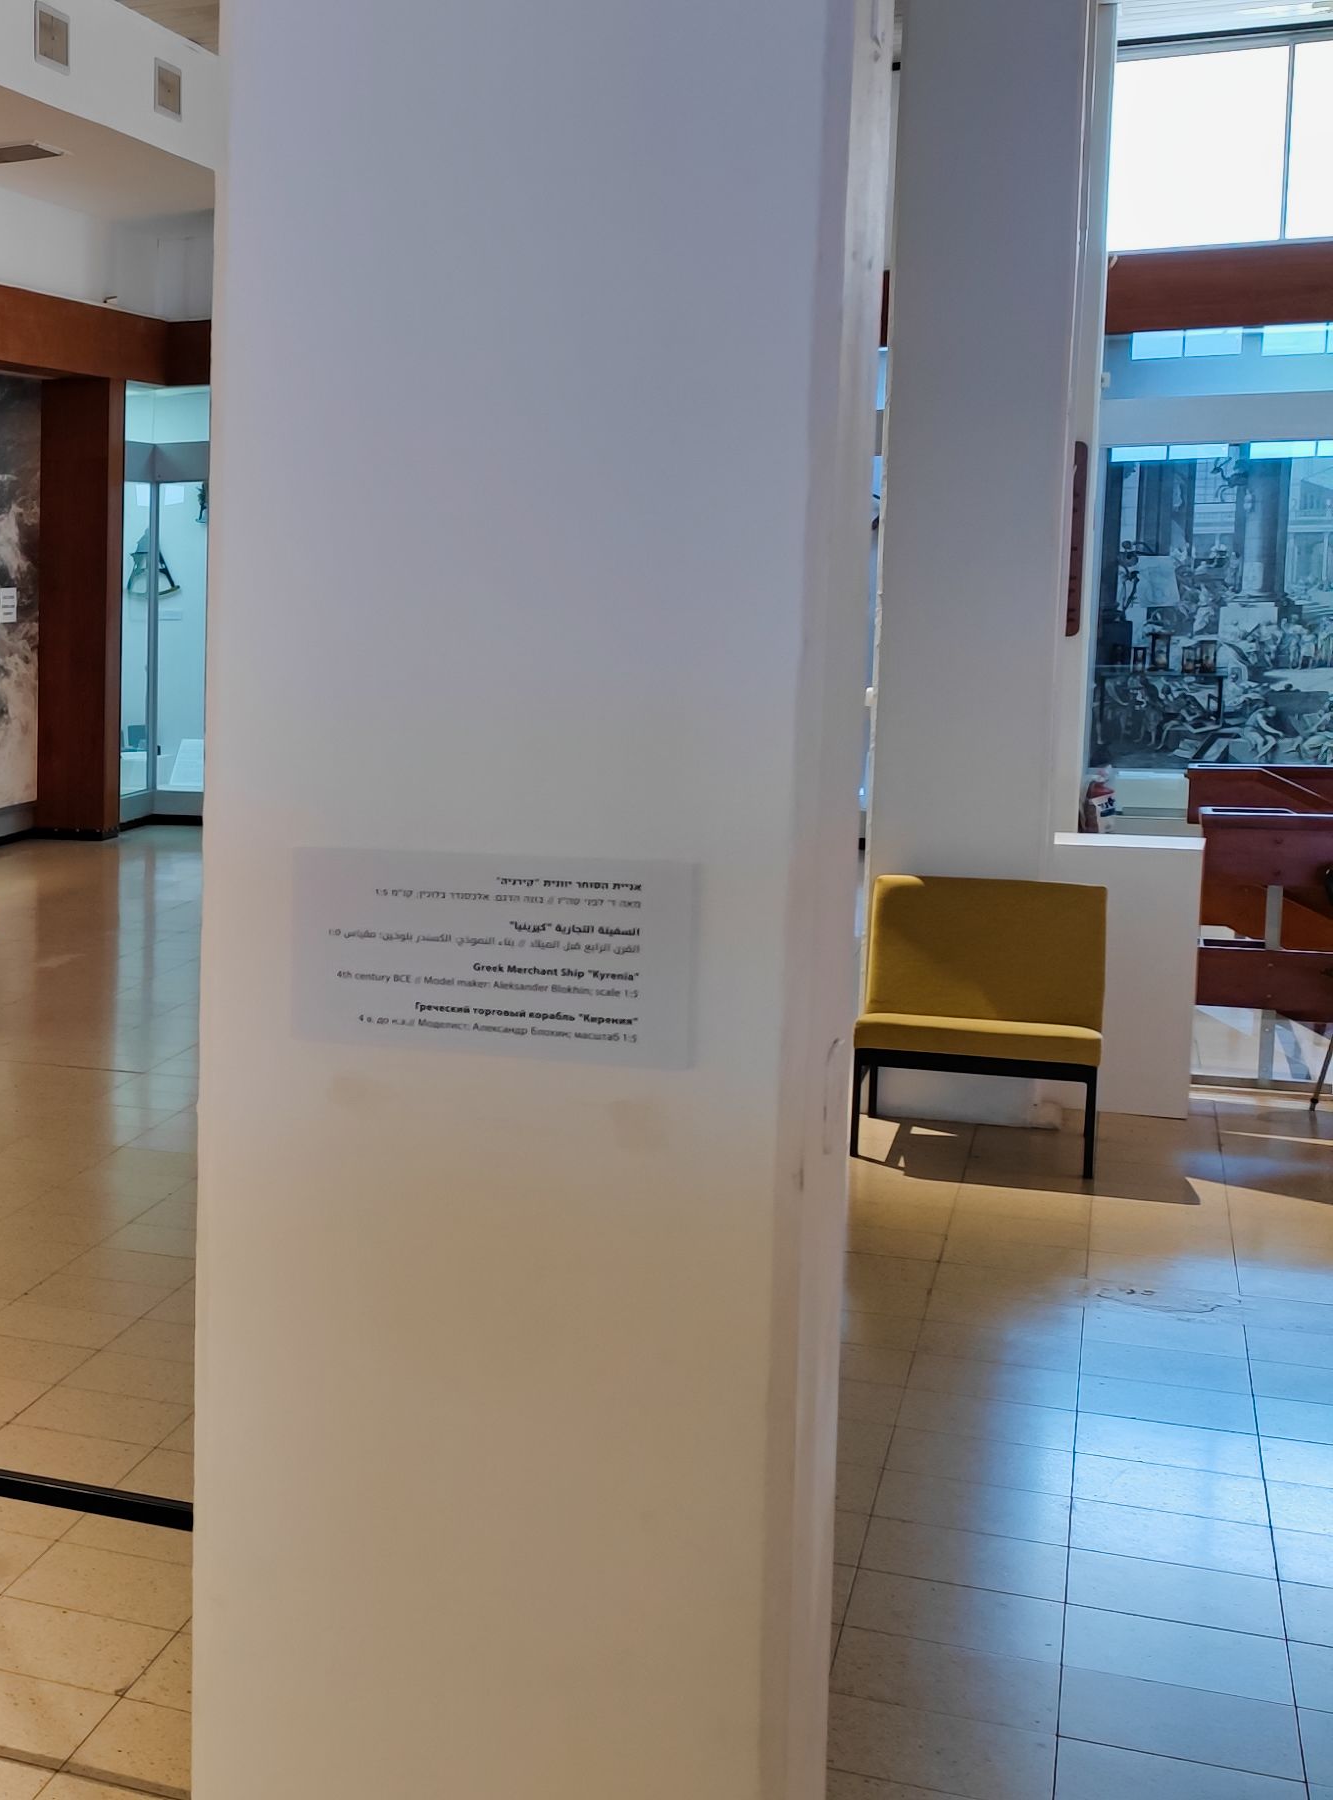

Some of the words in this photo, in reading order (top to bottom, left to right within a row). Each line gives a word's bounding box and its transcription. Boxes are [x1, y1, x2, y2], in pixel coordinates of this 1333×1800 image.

[555, 924, 594, 935] التجارية
[598, 926, 640, 937] السفينة
[473, 963, 505, 972] Greek
[507, 965, 558, 976] Merchant
[560, 968, 585, 979] Ship
[588, 970, 639, 981] "Kyrenia"
[354, 973, 391, 983] century
[393, 974, 412, 983] BCE
[424, 976, 455, 986] Model
[457, 980, 491, 988] maker:
[493, 981, 549, 992] Aleksander
[595, 988, 621, 997] scale
[624, 989, 639, 998] 1:5
[415, 1002, 470, 1013] Греческий
[473, 1008, 526, 1017] торговый
[529, 1012, 576, 1021] корабль
[579, 1014, 638, 1025] "Кирения"
[376, 1017, 390, 1025] до
[472, 1023, 528, 1036] Александр
[574, 1032, 620, 1041] масштаб
